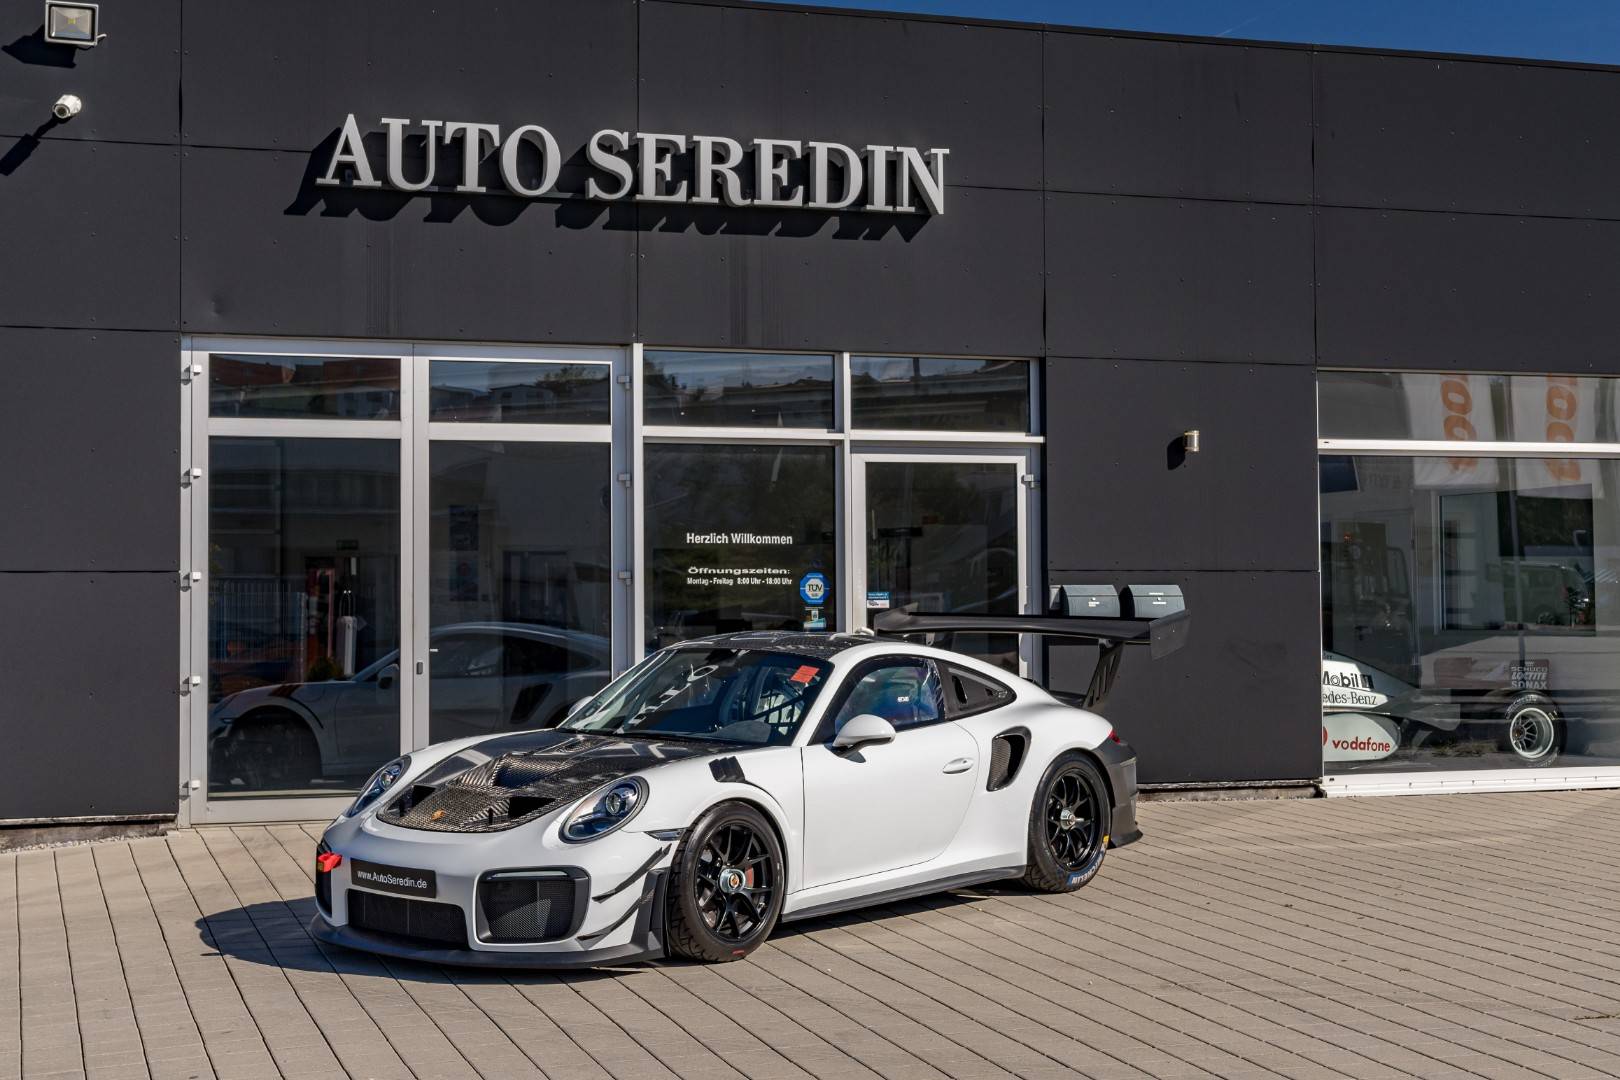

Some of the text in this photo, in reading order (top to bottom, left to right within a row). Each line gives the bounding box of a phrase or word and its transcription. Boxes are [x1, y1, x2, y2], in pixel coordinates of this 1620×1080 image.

[315, 113, 950, 216] AUTO SEREDIN
[686, 533, 793, 545] Herzlich Willkommen
[687, 566, 791, 575] Öffnungszeiten:
[687, 577, 709, 586] Montag
[713, 577, 734, 586] Freitag
[737, 577, 750, 585] 8:00
[750, 577, 761, 585] Uhr
[766, 577, 781, 585] 18:00
[781, 577, 793, 585] Uhr
[807, 583, 823, 592] TÜV
[1511, 681, 1548, 690] SONAX
[1332, 736, 1391, 753] vodafone
